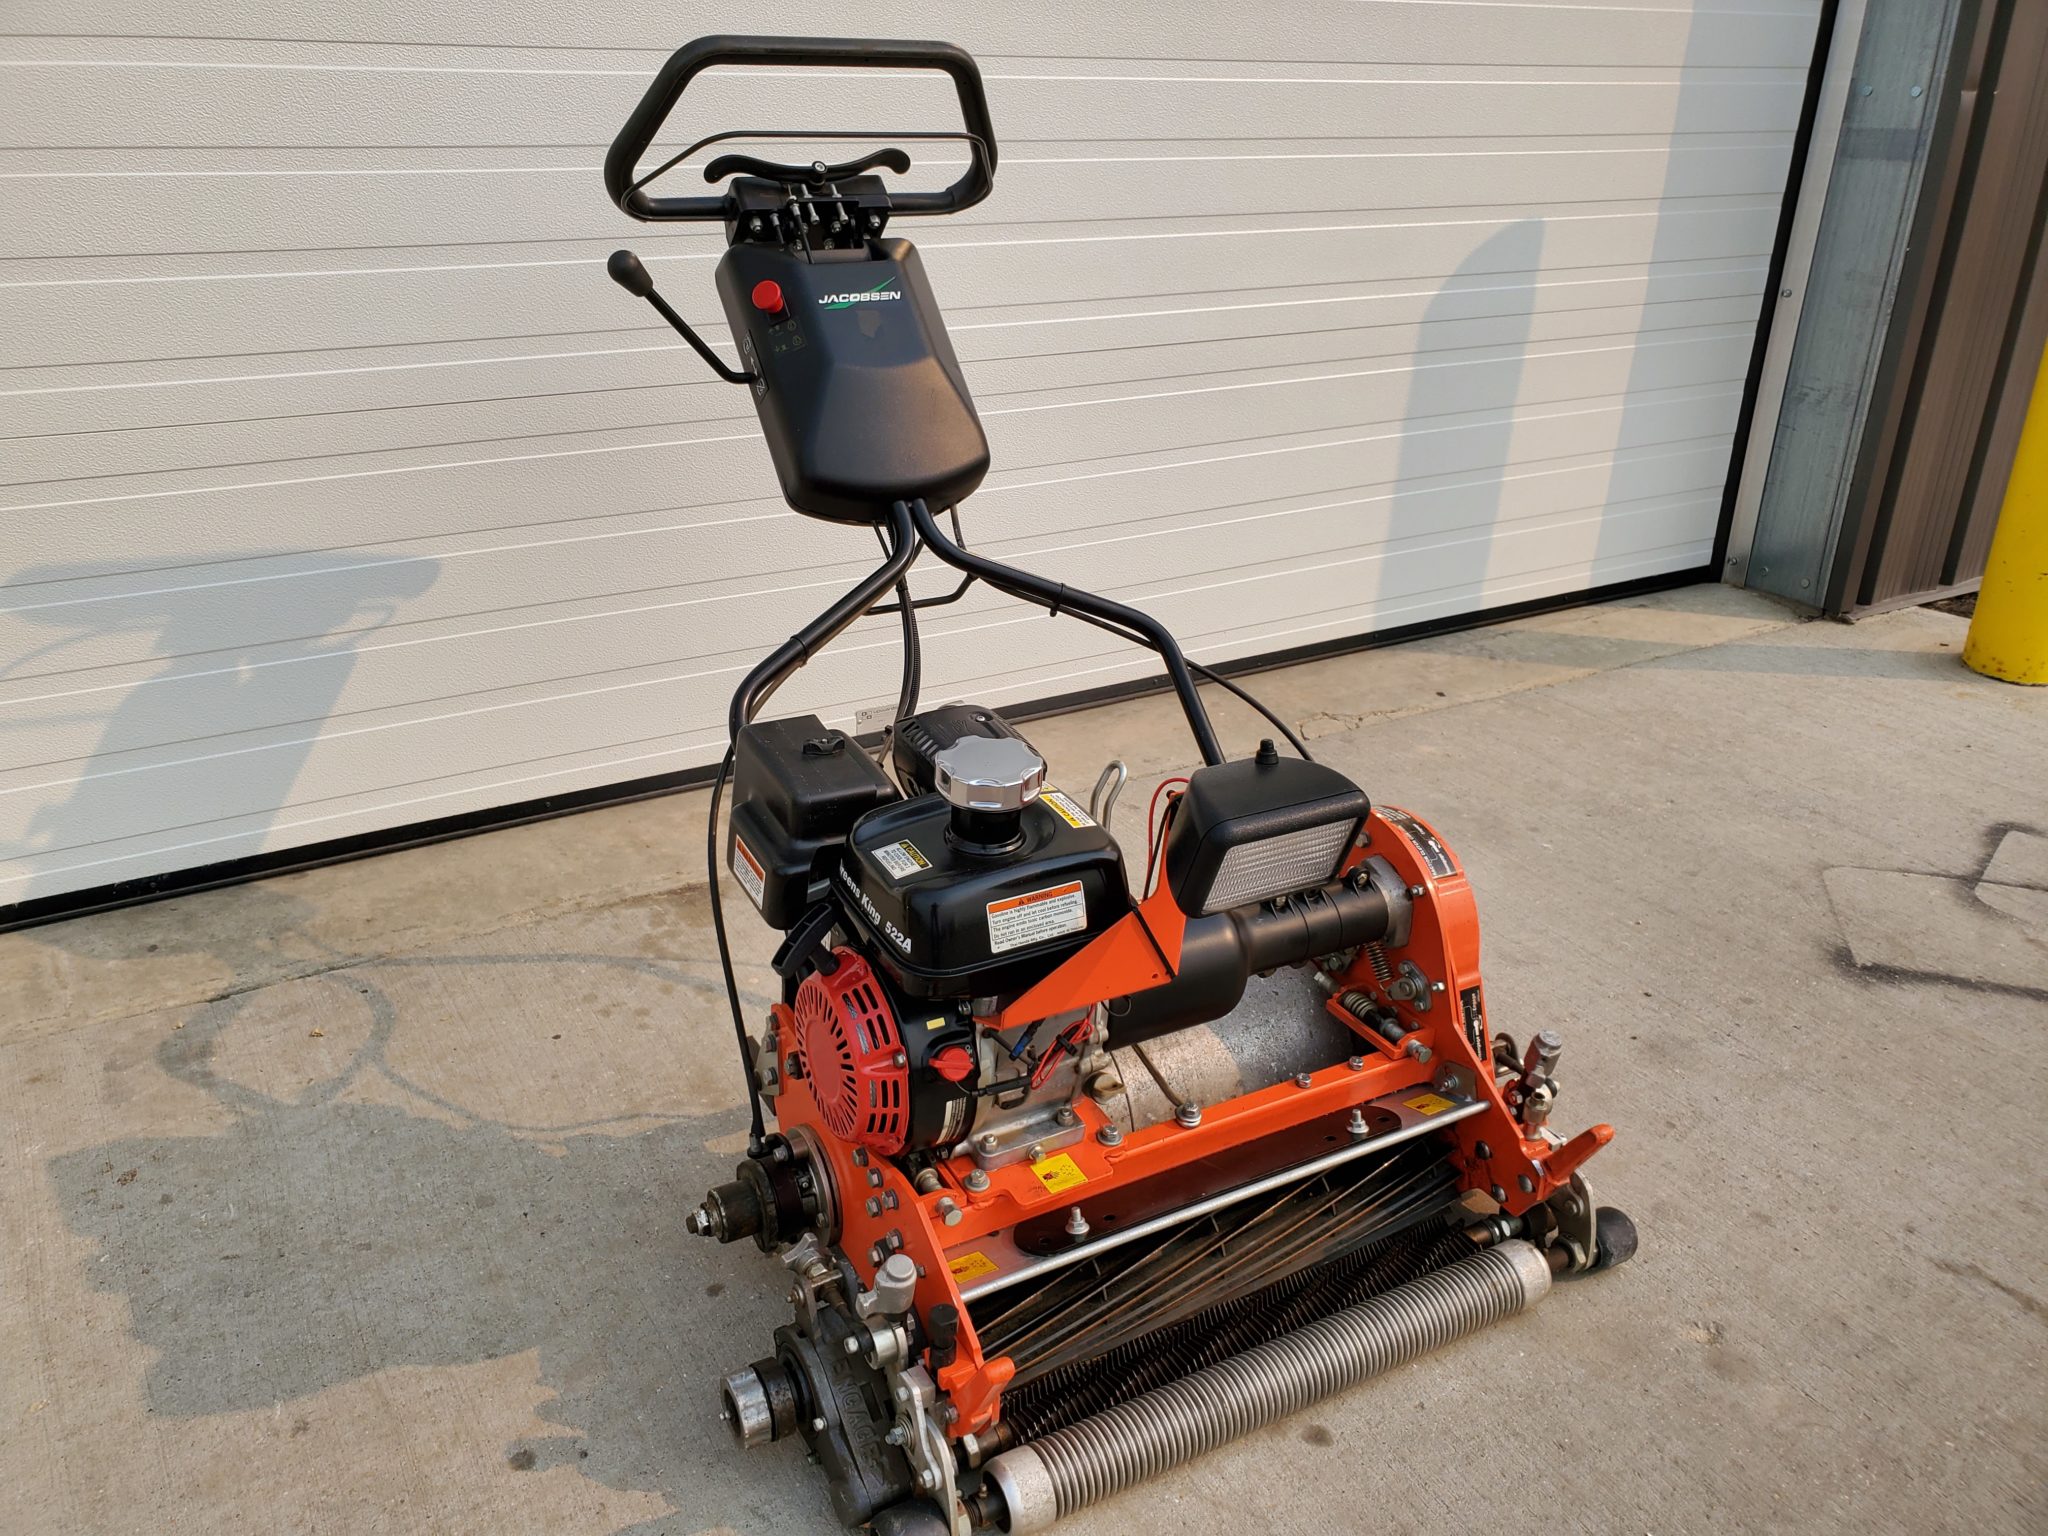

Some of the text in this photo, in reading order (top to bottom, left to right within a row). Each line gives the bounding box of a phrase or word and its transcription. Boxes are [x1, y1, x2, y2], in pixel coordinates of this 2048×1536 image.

[818, 291, 901, 304] JACOBSEN
[905, 847, 926, 865] CAUTION
[1027, 891, 1052, 903] WARNING
[840, 860, 912, 954] reens King 522A
